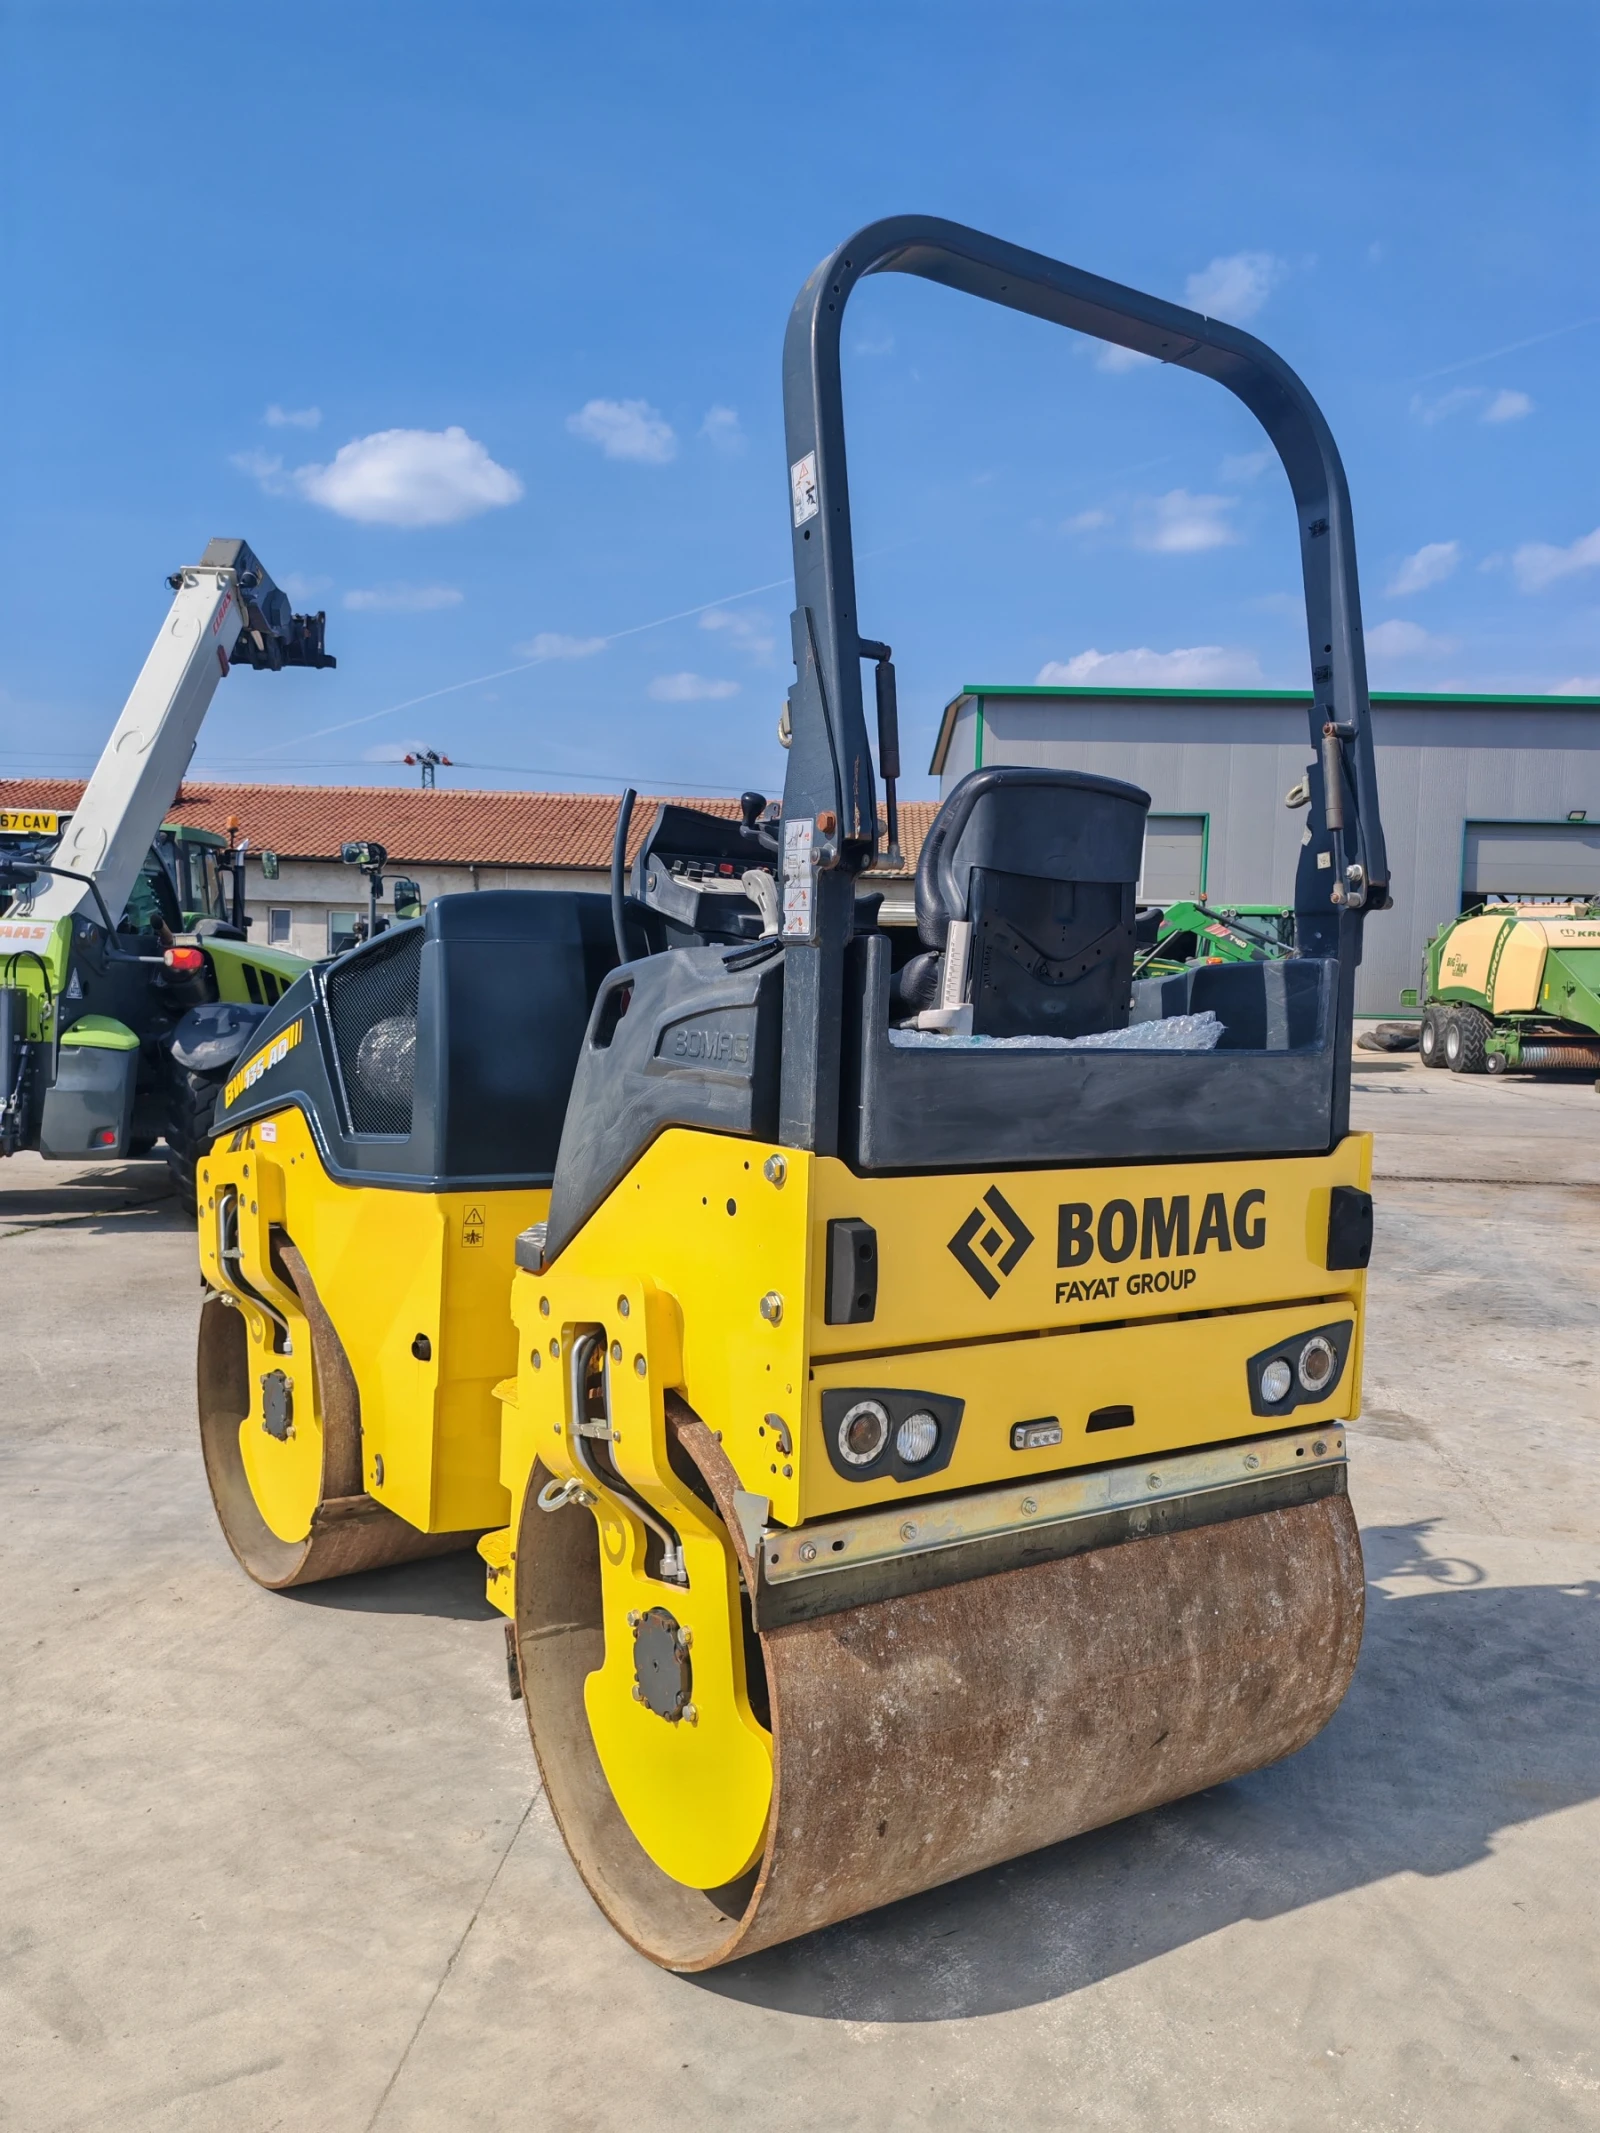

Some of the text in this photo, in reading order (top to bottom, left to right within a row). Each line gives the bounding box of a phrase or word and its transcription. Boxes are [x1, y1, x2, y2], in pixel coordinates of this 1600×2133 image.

[212, 589, 232, 636] CLAAS
[0, 814, 51, 829] 67 CAV
[1489, 923, 1510, 987] KRONE
[674, 1030, 750, 1063] BOMAG
[1057, 1188, 1266, 1268] BOMAG
[1055, 1268, 1197, 1304] FAYAT GROUP
